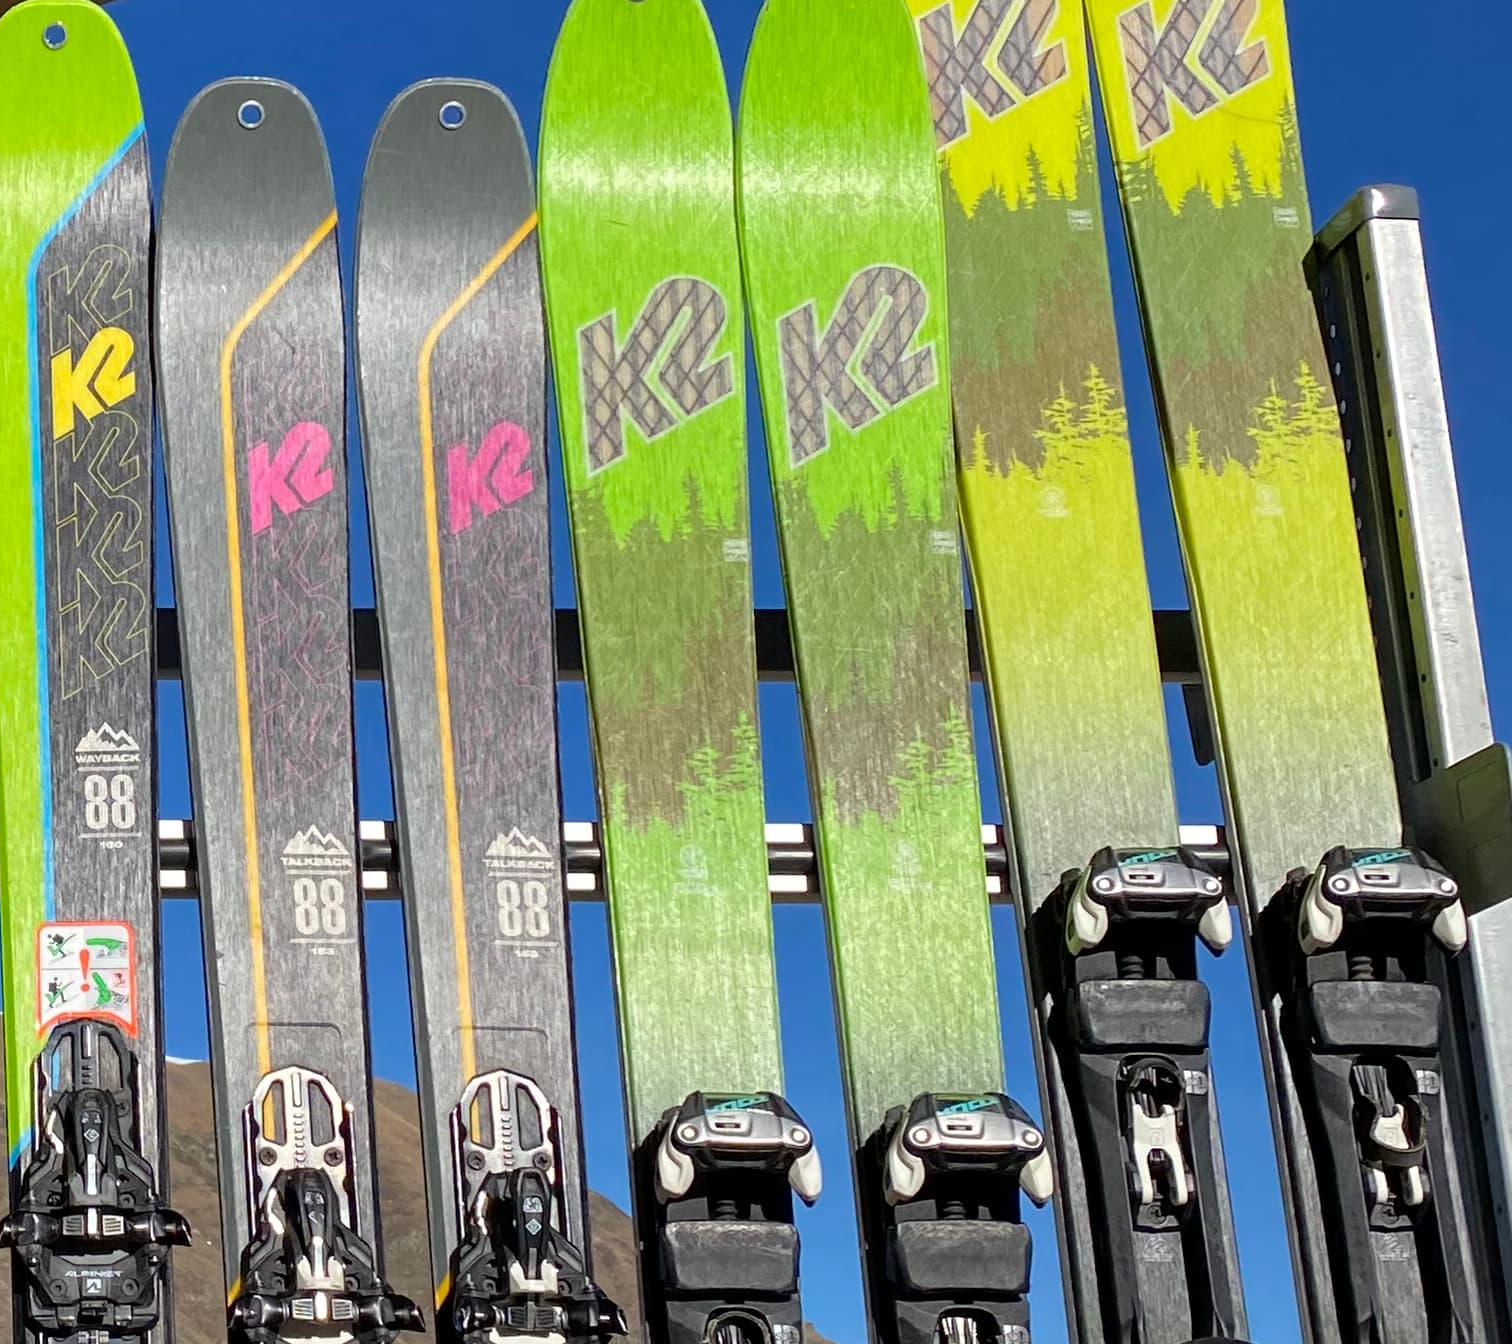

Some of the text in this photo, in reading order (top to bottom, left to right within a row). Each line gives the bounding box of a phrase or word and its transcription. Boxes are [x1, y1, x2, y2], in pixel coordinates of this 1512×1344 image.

[51, 327, 136, 440] K2
[577, 274, 734, 477] K2
[776, 263, 938, 468] K2
[248, 421, 334, 535] K2
[447, 421, 534, 535] K2
[75, 754, 140, 763] WAYBACK
[84, 774, 136, 830] 88
[280, 857, 352, 868] TALKBACK
[483, 858, 555, 870] TALKBACK
[294, 877, 345, 935] 88
[496, 879, 551, 937] 88
